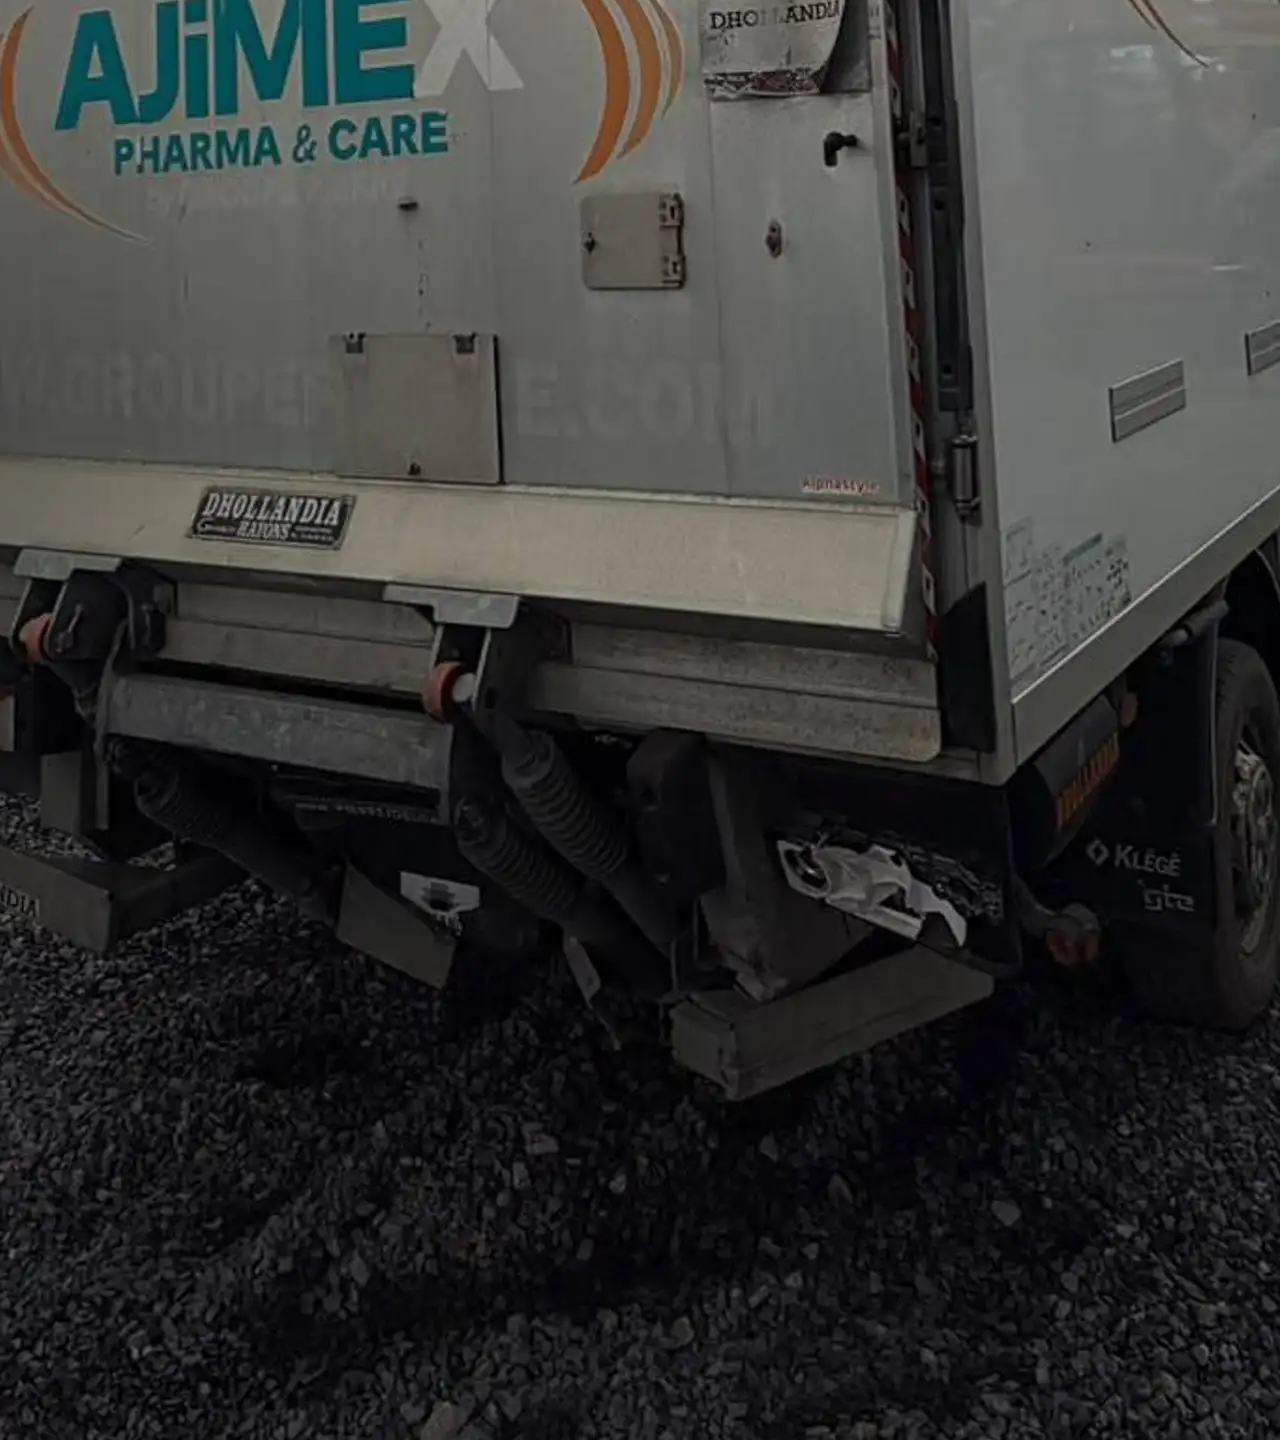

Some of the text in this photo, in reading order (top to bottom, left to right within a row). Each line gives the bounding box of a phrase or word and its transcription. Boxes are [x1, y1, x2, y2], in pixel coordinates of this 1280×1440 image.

[114, 111, 448, 176] PHARMA & CARE
[202, 492, 341, 527] DHOLLANDIA
